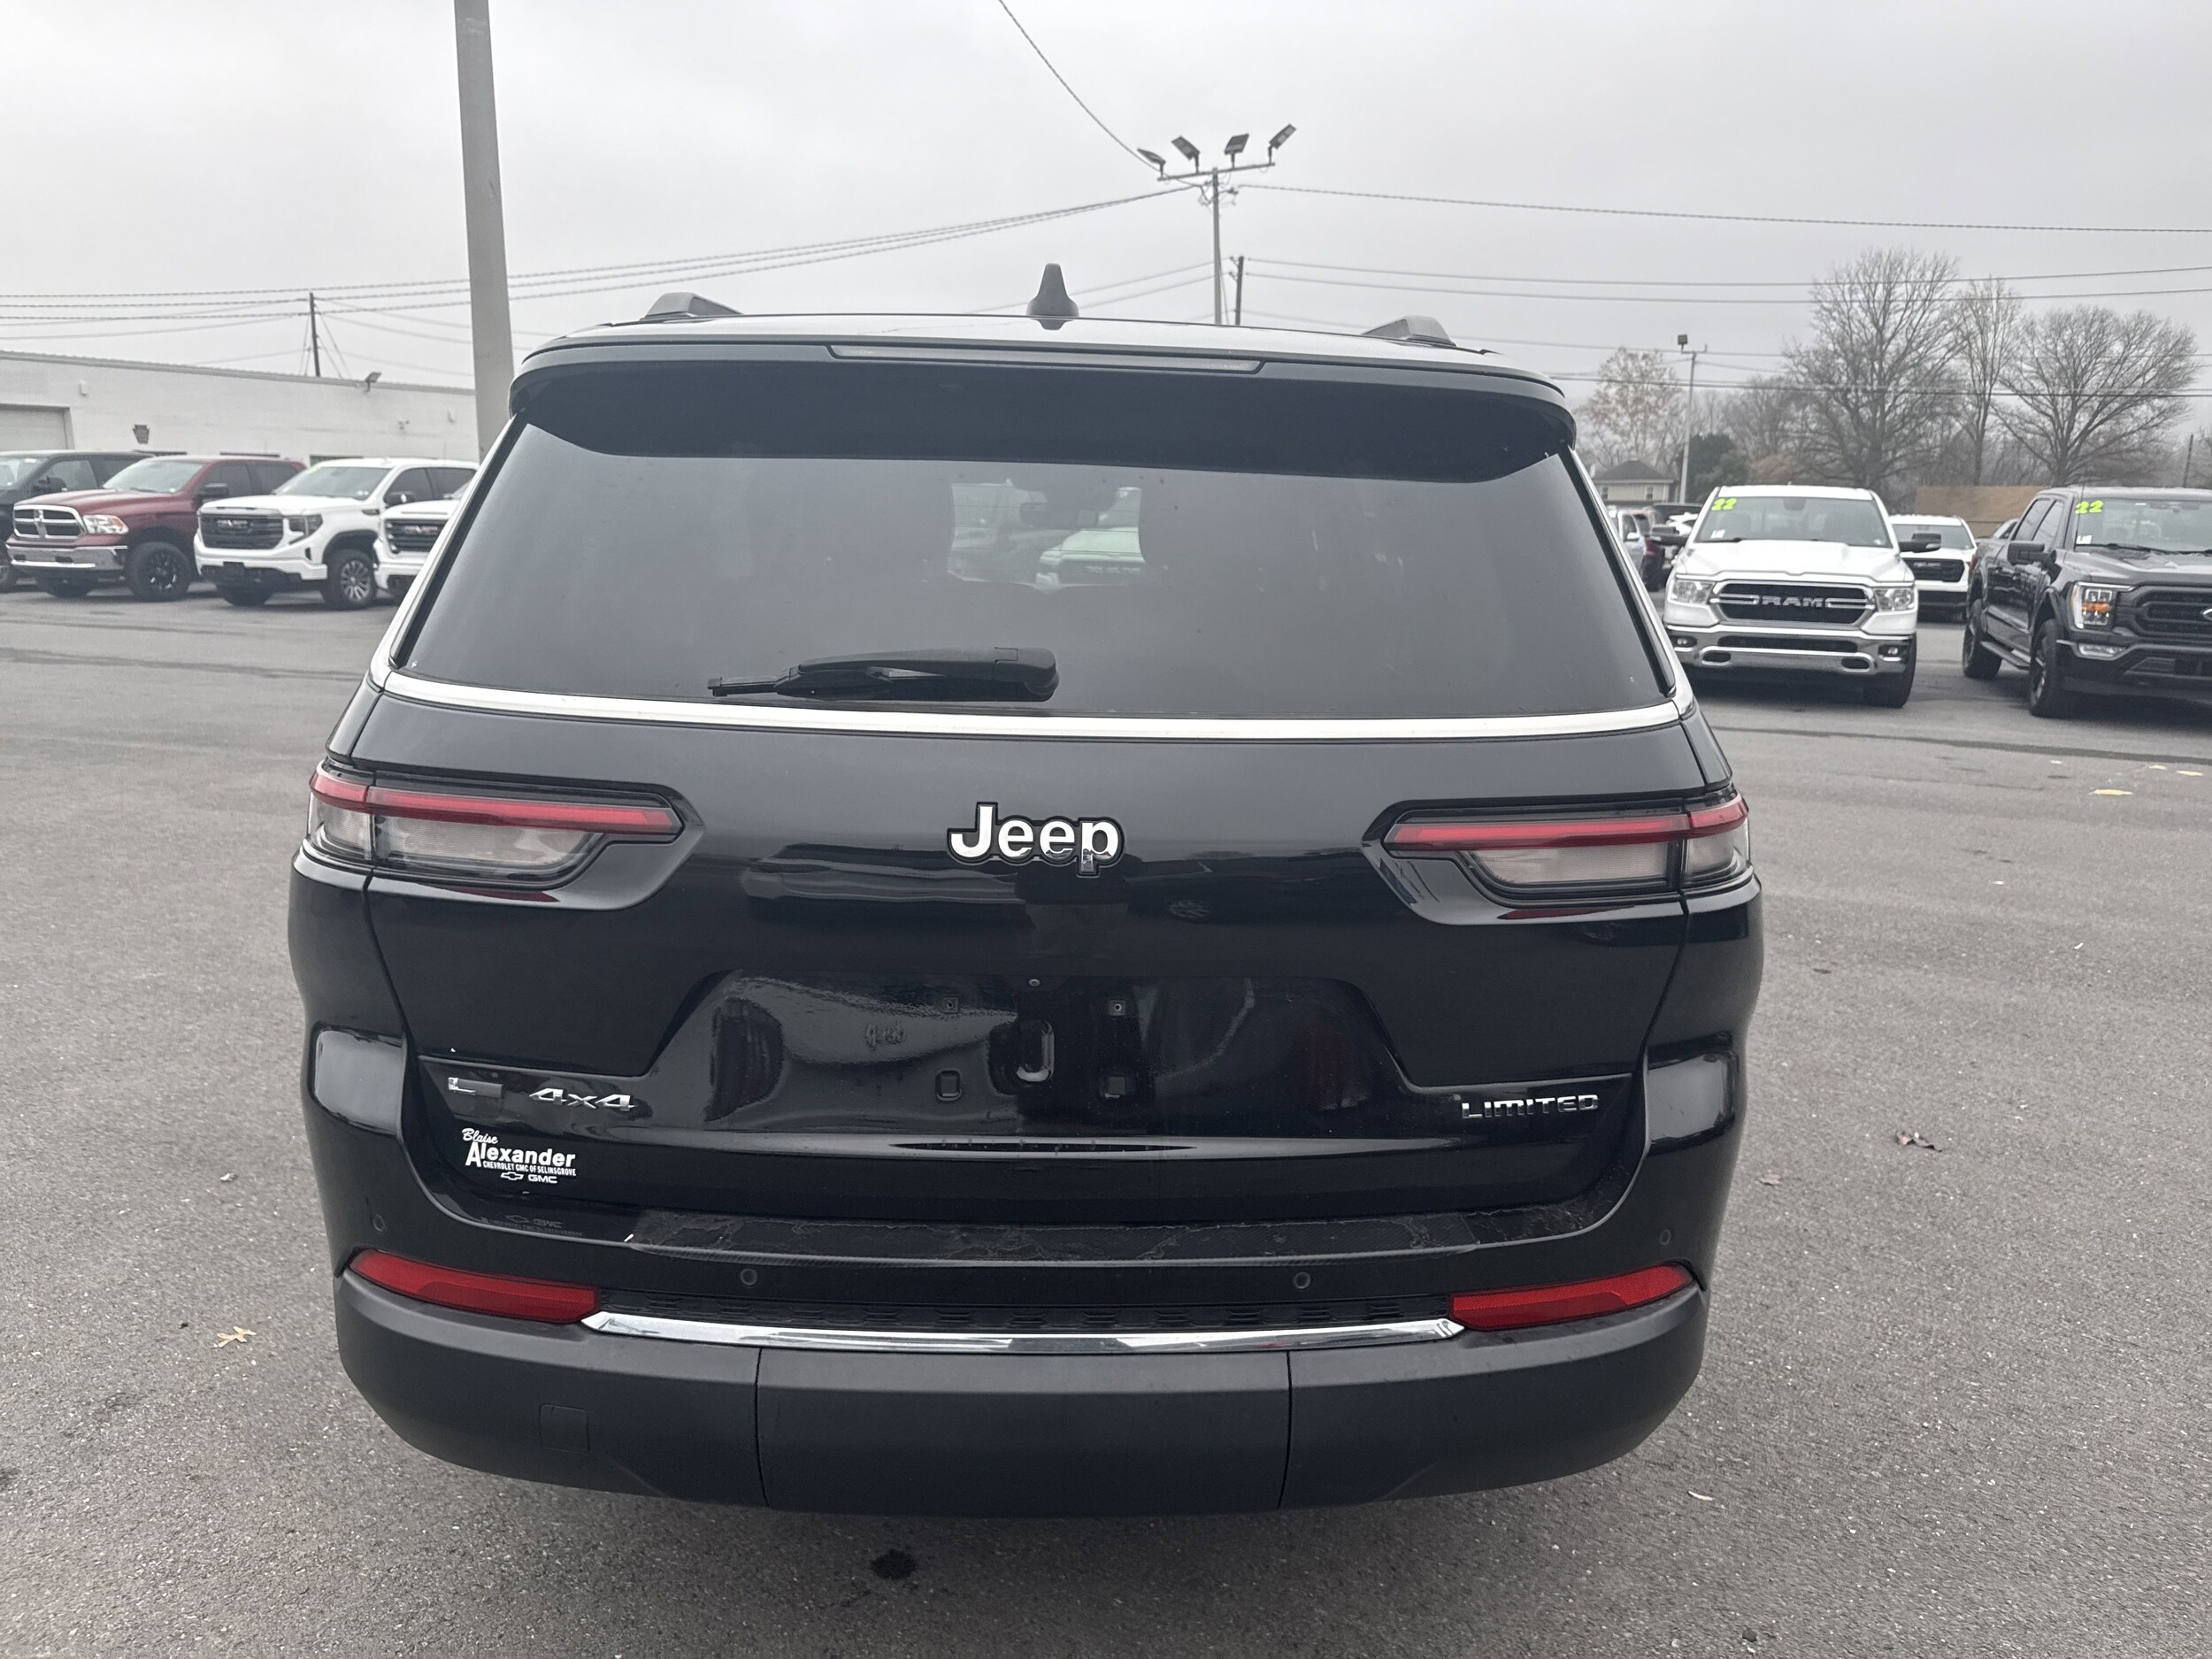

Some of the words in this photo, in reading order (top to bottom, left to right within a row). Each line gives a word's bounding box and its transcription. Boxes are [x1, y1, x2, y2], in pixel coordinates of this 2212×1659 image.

[2074, 500, 2104, 514] 22
[1762, 595, 1824, 608] RAM
[949, 803, 1122, 876] Jeep
[529, 1087, 636, 1111] 4x4
[1461, 1094, 1600, 1119] LIMITED
[462, 1127, 499, 1145] Blaise
[465, 1141, 576, 1168] Alexander
[482, 1160, 516, 1171] CHEVROLET
[515, 1163, 530, 1172] GMC
[529, 1164, 537, 1173] OF
[537, 1165, 577, 1177] SELINSGROVE
[527, 1173, 558, 1184] GMC
